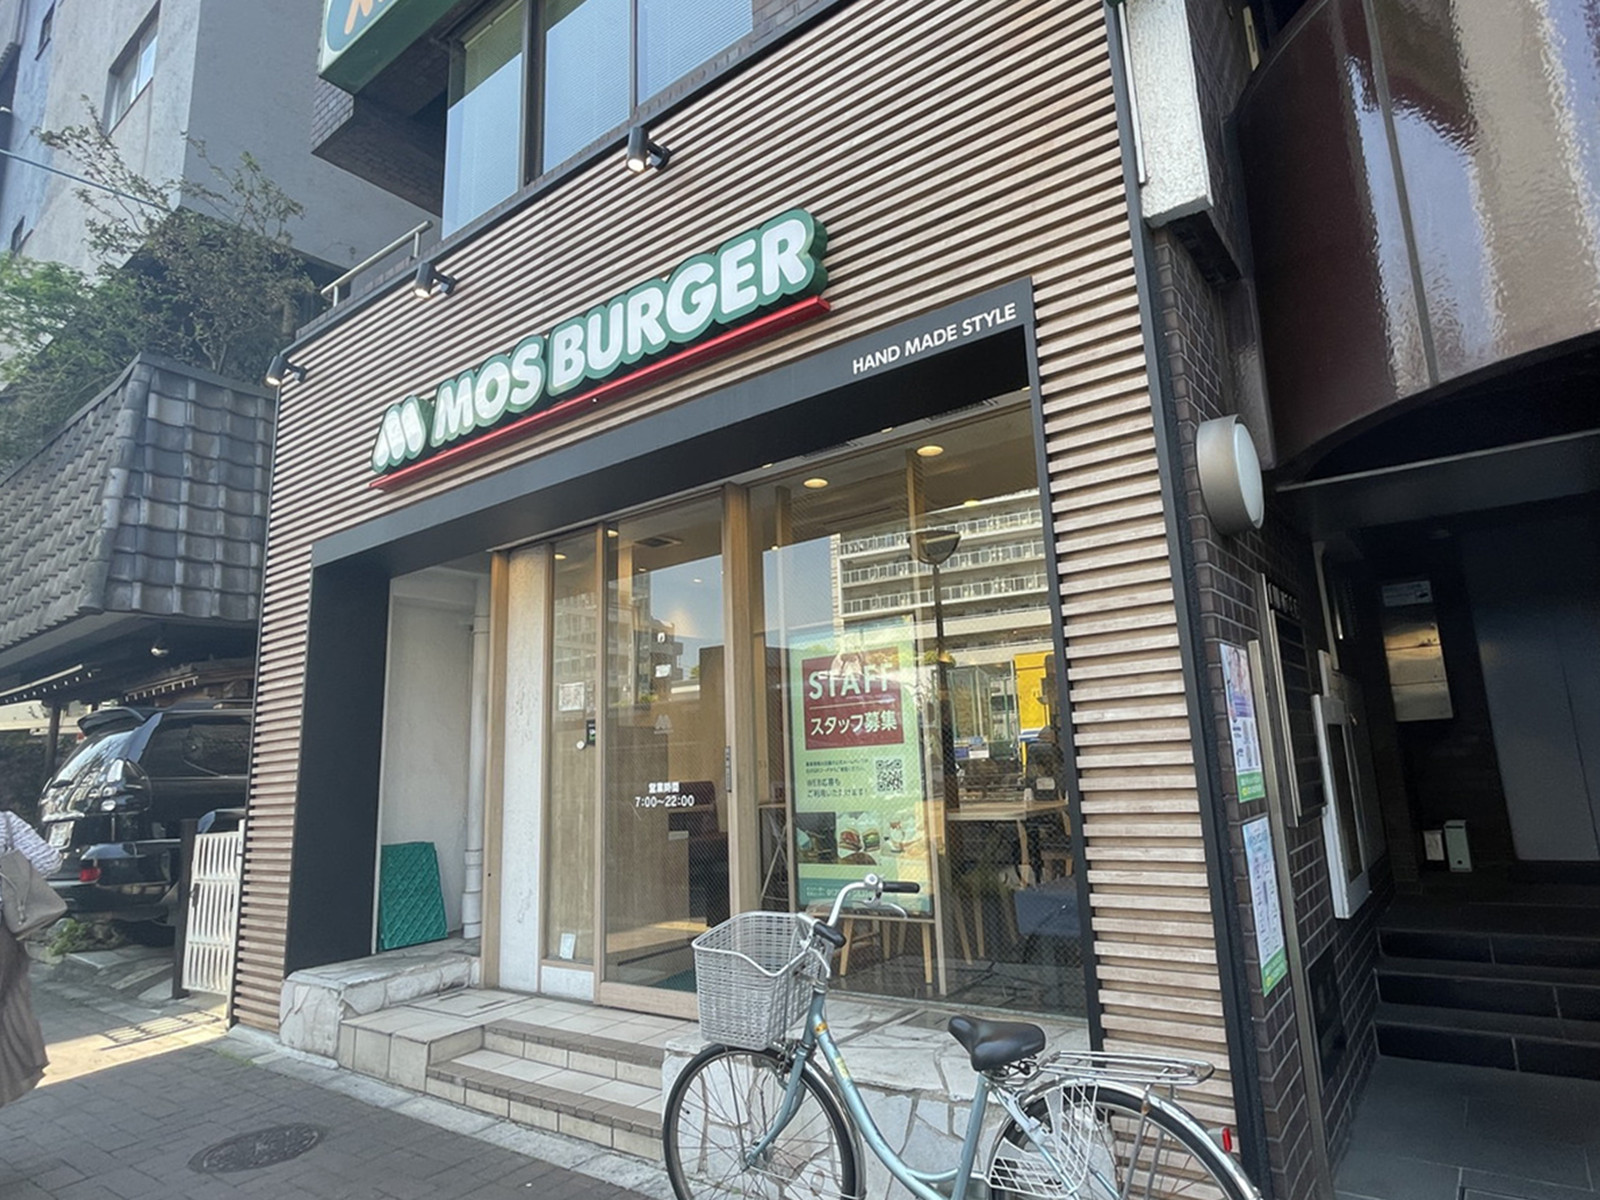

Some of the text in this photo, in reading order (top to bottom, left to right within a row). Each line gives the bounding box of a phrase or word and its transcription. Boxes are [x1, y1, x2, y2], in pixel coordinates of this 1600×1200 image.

[433, 341, 543, 442] MOS
[551, 219, 808, 388] BURGER
[852, 302, 1017, 375] HAND MADE STYLE
[808, 663, 893, 700] STAFF
[810, 710, 898, 736] スタッフ募集
[648, 781, 680, 794] 営業時間
